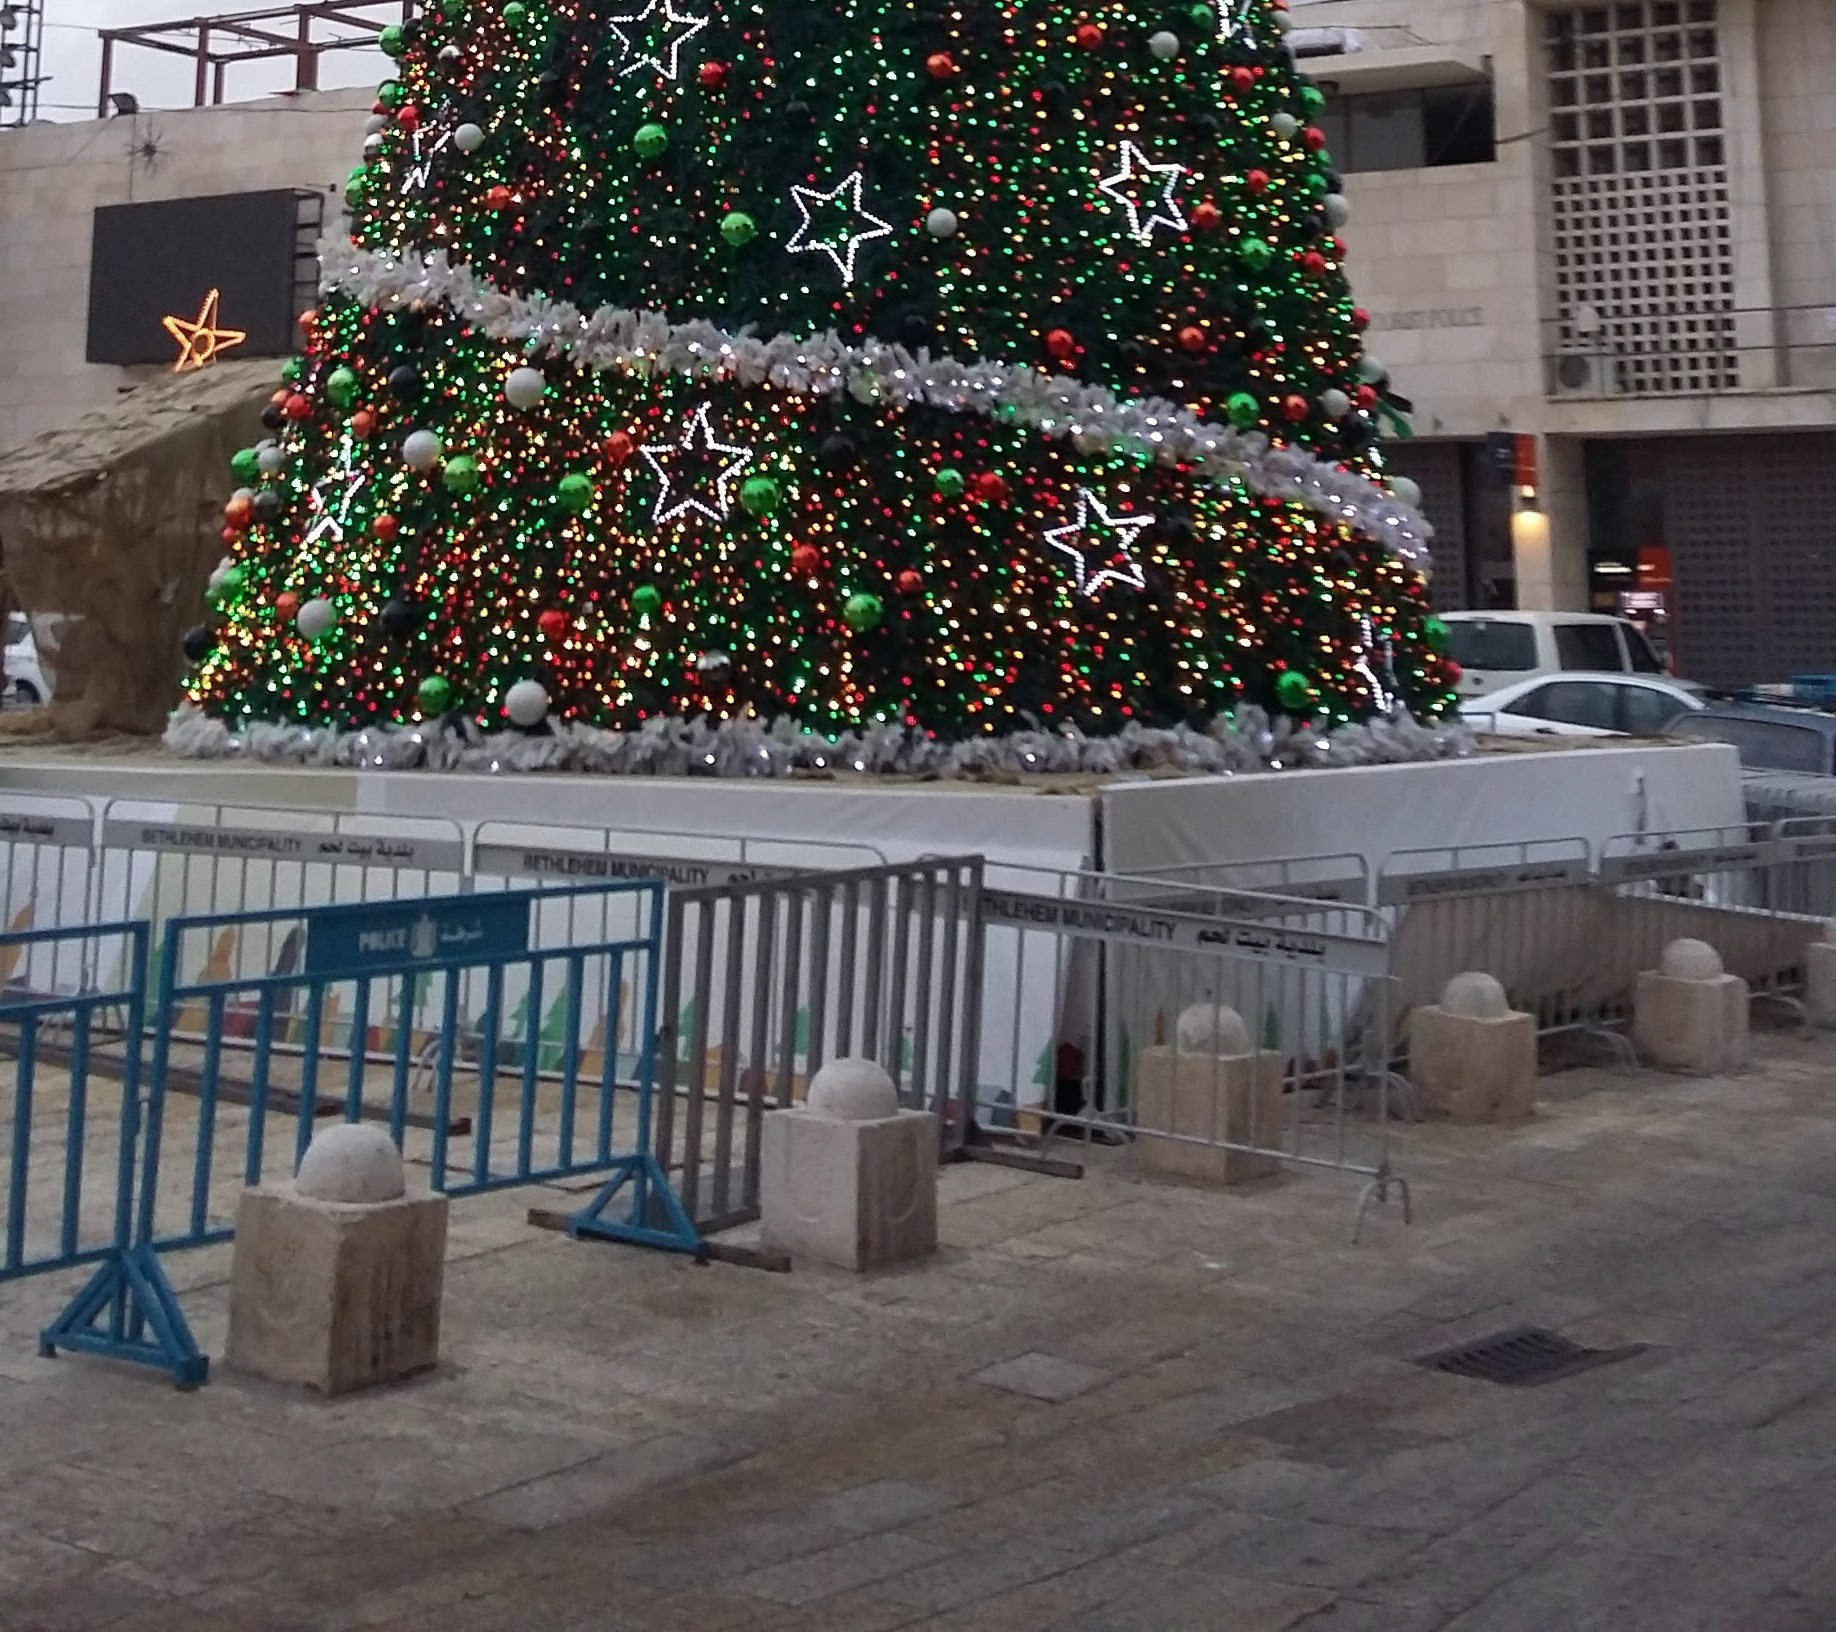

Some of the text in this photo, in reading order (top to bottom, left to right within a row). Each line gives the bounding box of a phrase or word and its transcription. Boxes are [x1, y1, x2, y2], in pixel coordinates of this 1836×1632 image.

[142, 828, 301, 853] BETHLEHEM MUNICIPALITY
[524, 853, 606, 876] BETHLEHEM
[1062, 908, 1177, 941] MUNICIPALITY
